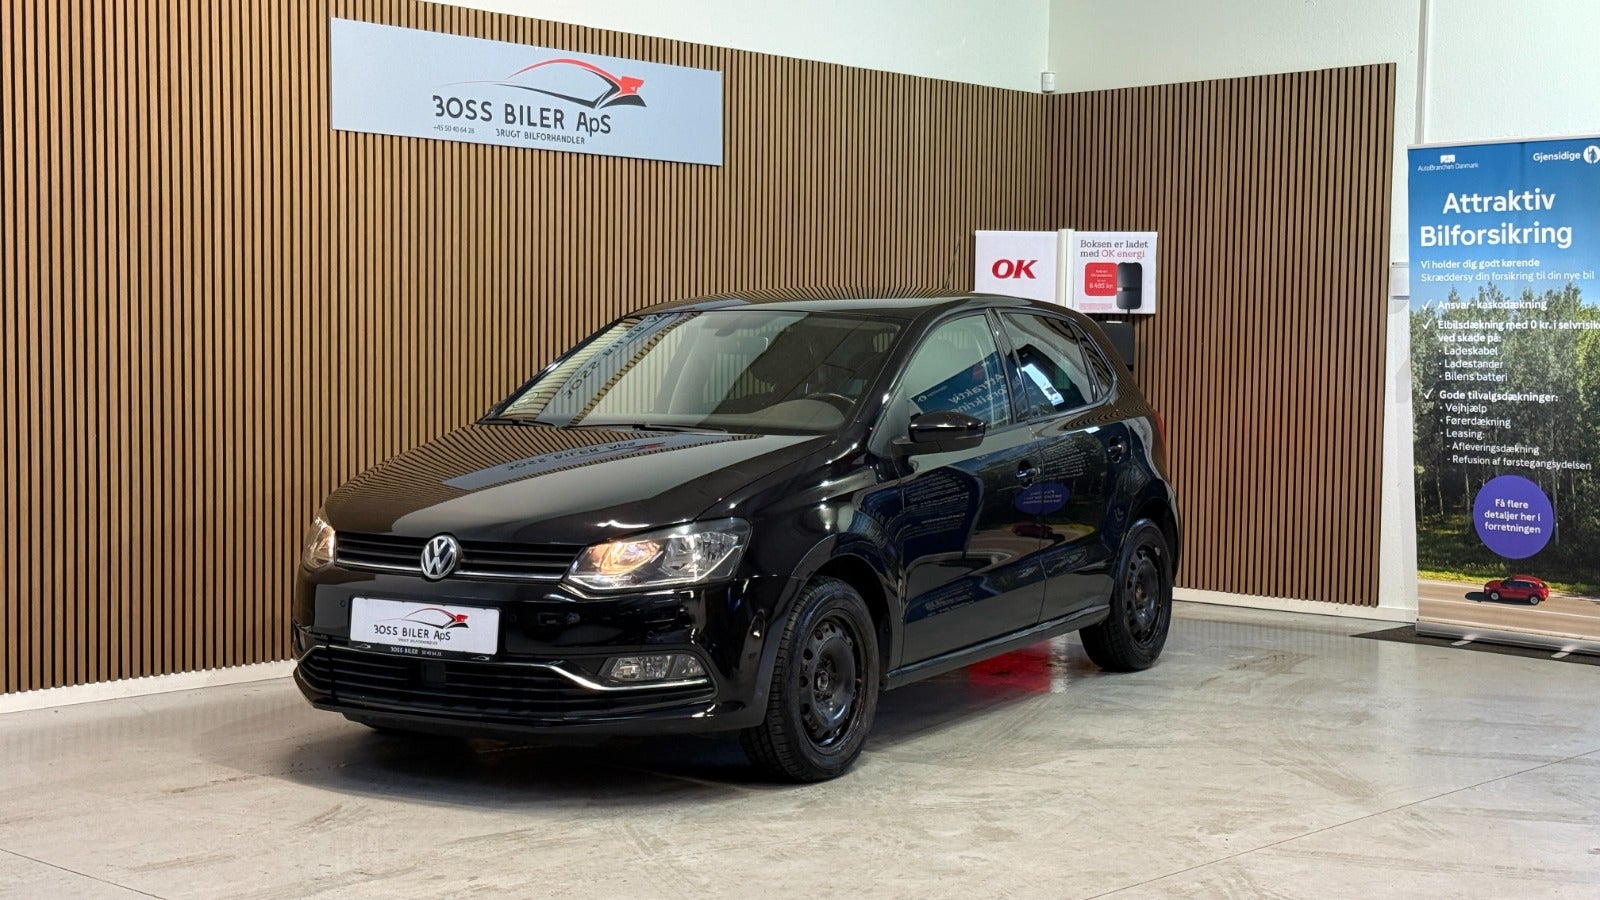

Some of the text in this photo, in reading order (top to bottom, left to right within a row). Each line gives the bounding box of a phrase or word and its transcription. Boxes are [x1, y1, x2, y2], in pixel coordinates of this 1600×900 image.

[504, 103, 565, 130] BILER
[576, 111, 611, 137] ApS
[524, 131, 586, 145] BILFORHANDLER
[1532, 151, 1581, 163] Gjensidige
[1442, 187, 1556, 214] Attraktiv
[1420, 221, 1573, 249] Bilforsikring
[1080, 239, 1112, 248] Boksen
[1126, 240, 1148, 249] ladet
[1080, 250, 1146, 260] med OK energi
[991, 258, 1038, 279] OK
[1420, 258, 1540, 270] Vi holder dig godt kørende
[1420, 270, 1595, 283] Skræddersy din forsikring til din nye bil
[1437, 299, 1548, 311] Ansvar- kaskodækning
[1437, 320, 1504, 332] Elbilsdækning
[1505, 320, 1528, 330] med
[1530, 320, 1537, 329] 0
[1539, 320, 1552, 330] kr.
[1553, 320, 1557, 330] i
[1438, 333, 1502, 345] ved skade på:
[1444, 346, 1499, 356] Ladeskabel
[1444, 359, 1504, 369] Ladestander
[1444, 371, 1508, 382] Bilens batteri
[1439, 389, 1559, 404] Gode tilvalgsdækninger:
[1445, 402, 1488, 414] Vejhjælp
[1445, 415, 1511, 429] Førerdækning
[1446, 429, 1485, 441] Leasing:
[1452, 441, 1540, 456] Afleveringsdækning
[1452, 454, 1592, 471] Refusion af førstegangsydelsen
[1495, 499, 1529, 509] Få flere
[1484, 510, 1541, 521] detaljer her i
[1484, 522, 1541, 534] forretningen
[402, 627, 429, 639] BILER
[433, 630, 451, 641] ApS
